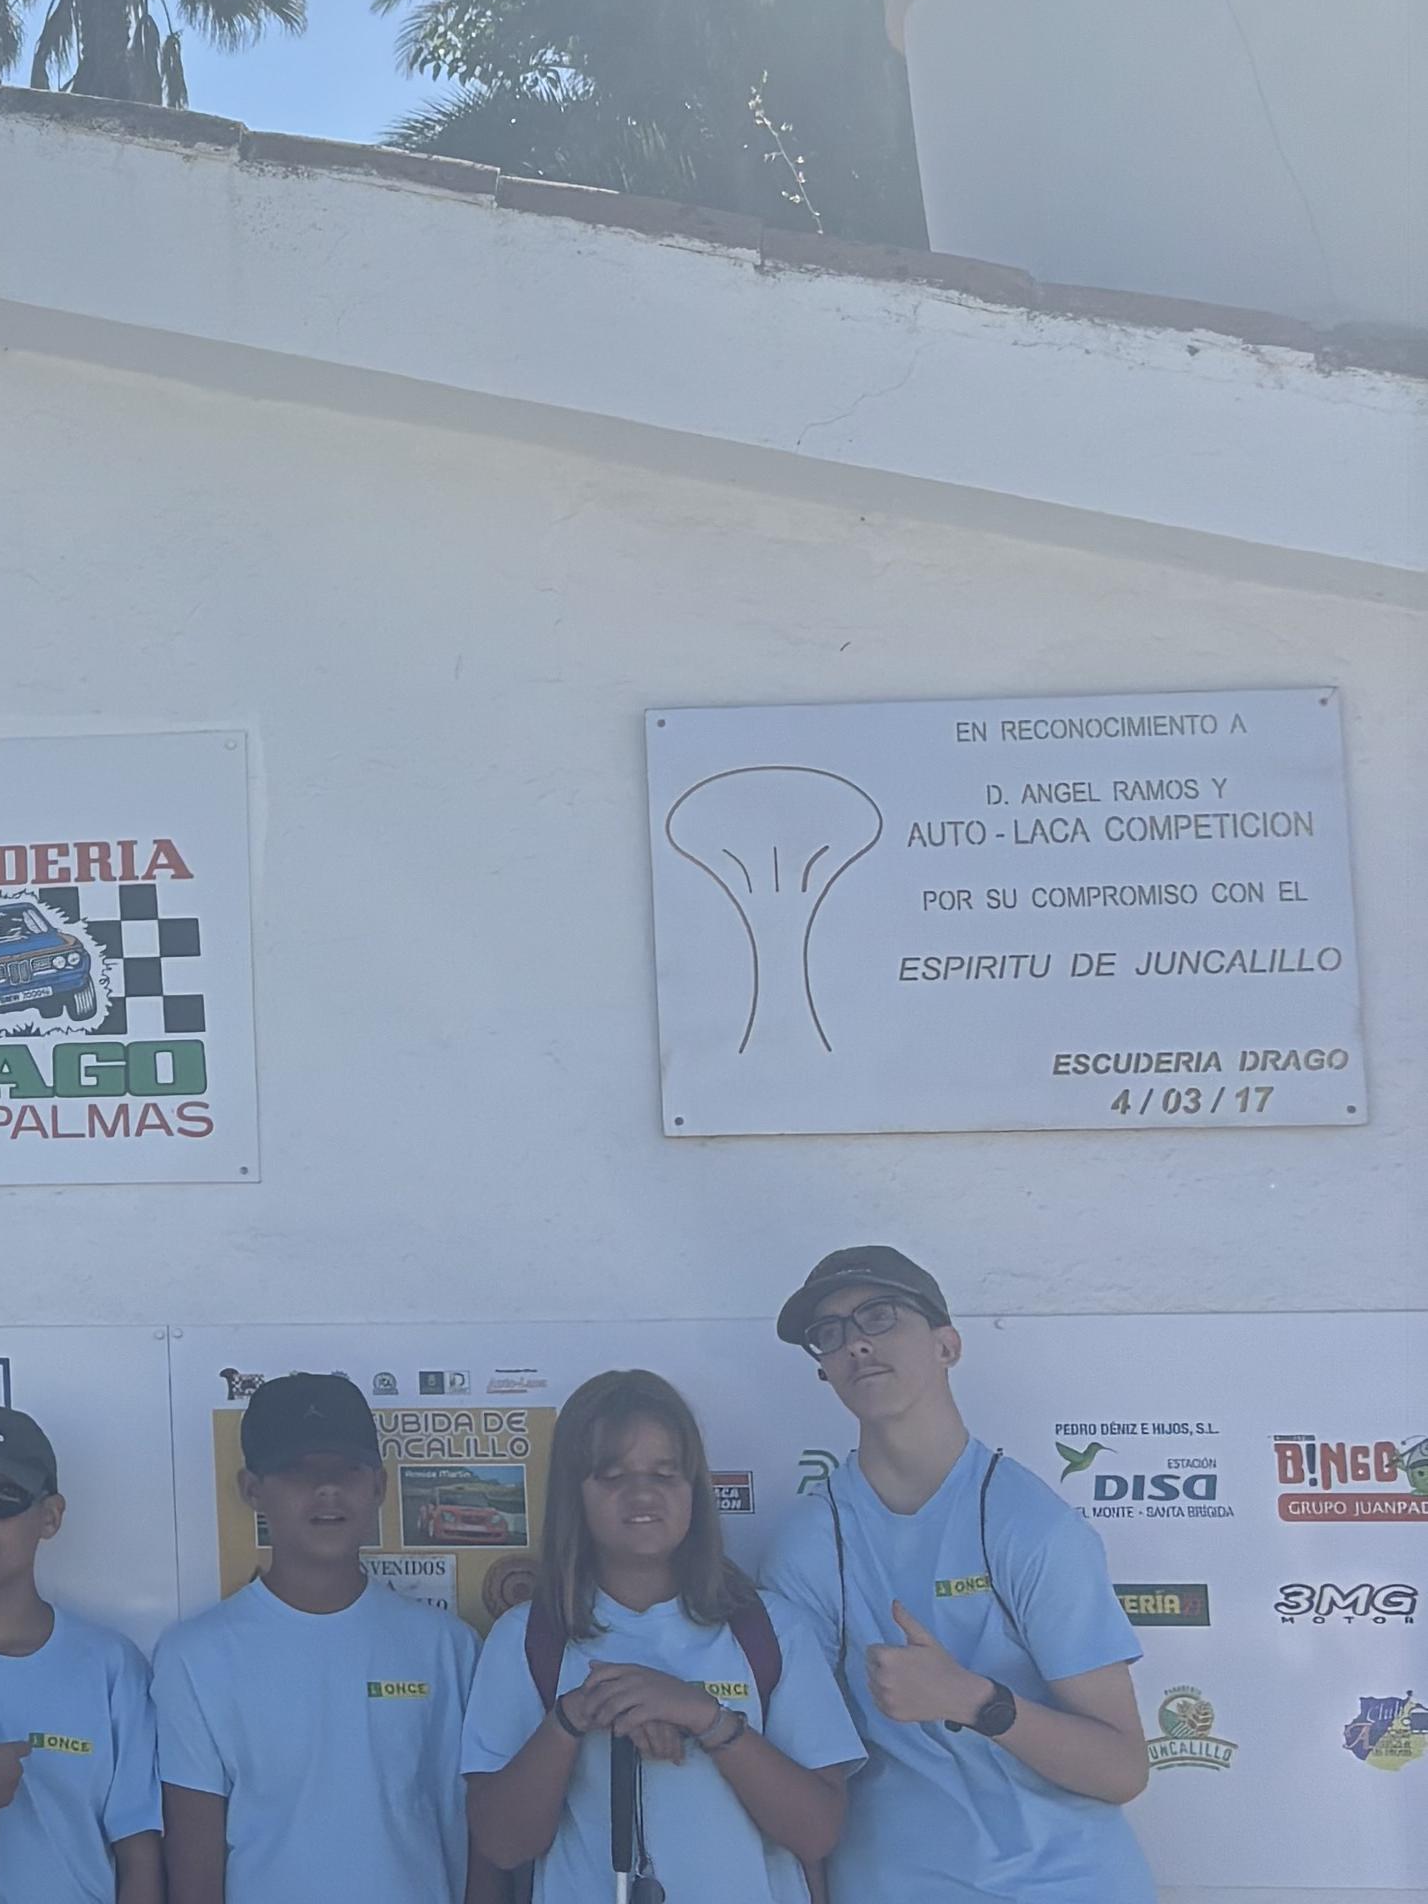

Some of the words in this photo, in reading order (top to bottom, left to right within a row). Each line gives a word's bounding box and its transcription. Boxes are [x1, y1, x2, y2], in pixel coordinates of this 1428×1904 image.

[956, 722, 987, 742] EN
[1001, 715, 1217, 741] RECONOCIMIENTO
[1230, 714, 1246, 735] A
[987, 784, 1008, 805] D.
[1021, 781, 1100, 804] ANGEL
[1113, 779, 1198, 802] RAMOS
[1212, 777, 1228, 799] Y
[907, 821, 988, 848] AUTO
[1013, 817, 1090, 845] LACA
[1105, 811, 1314, 843] COMPETICION
[923, 889, 973, 911] POR
[986, 888, 1018, 909] SU
[1032, 883, 1197, 909] COMPROMISO
[1211, 882, 1264, 904] CON
[1279, 881, 1308, 902] EL
[898, 953, 1051, 982] ESPIRITU
[1070, 951, 1116, 978] DE
[1135, 946, 1342, 977] JUNCALILLO
[1052, 1052, 1223, 1076] ESCUDERIA
[1240, 1049, 1349, 1072] DRAGO
[1111, 1088, 1131, 1114] 4
[1162, 1088, 1203, 1113] 03
[1236, 1086, 1274, 1113] 17
[379, 1411, 473, 1433] UBIDA
[483, 1410, 527, 1433] DE
[1055, 1423, 1096, 1435] PEDRO
[1101, 1421, 1137, 1435] DÉNIZ
[1141, 1423, 1149, 1434] E
[1153, 1423, 1193, 1436] HIJOS,
[1168, 1458, 1217, 1469] ESTACIÓN
[1094, 1474, 1217, 1501] DISA
[1093, 1506, 1134, 1518] MONTE
[1147, 1506, 1184, 1517] SANTA
[1288, 1501, 1346, 1515] GRUPO
[1274, 1584, 1418, 1616] 3MG
[1281, 1616, 1414, 1624] MOTOR
[385, 1683, 428, 1696] ONCE
[46, 1736, 92, 1754] ONCE
[1149, 1740, 1232, 1761] UNCALILLO
